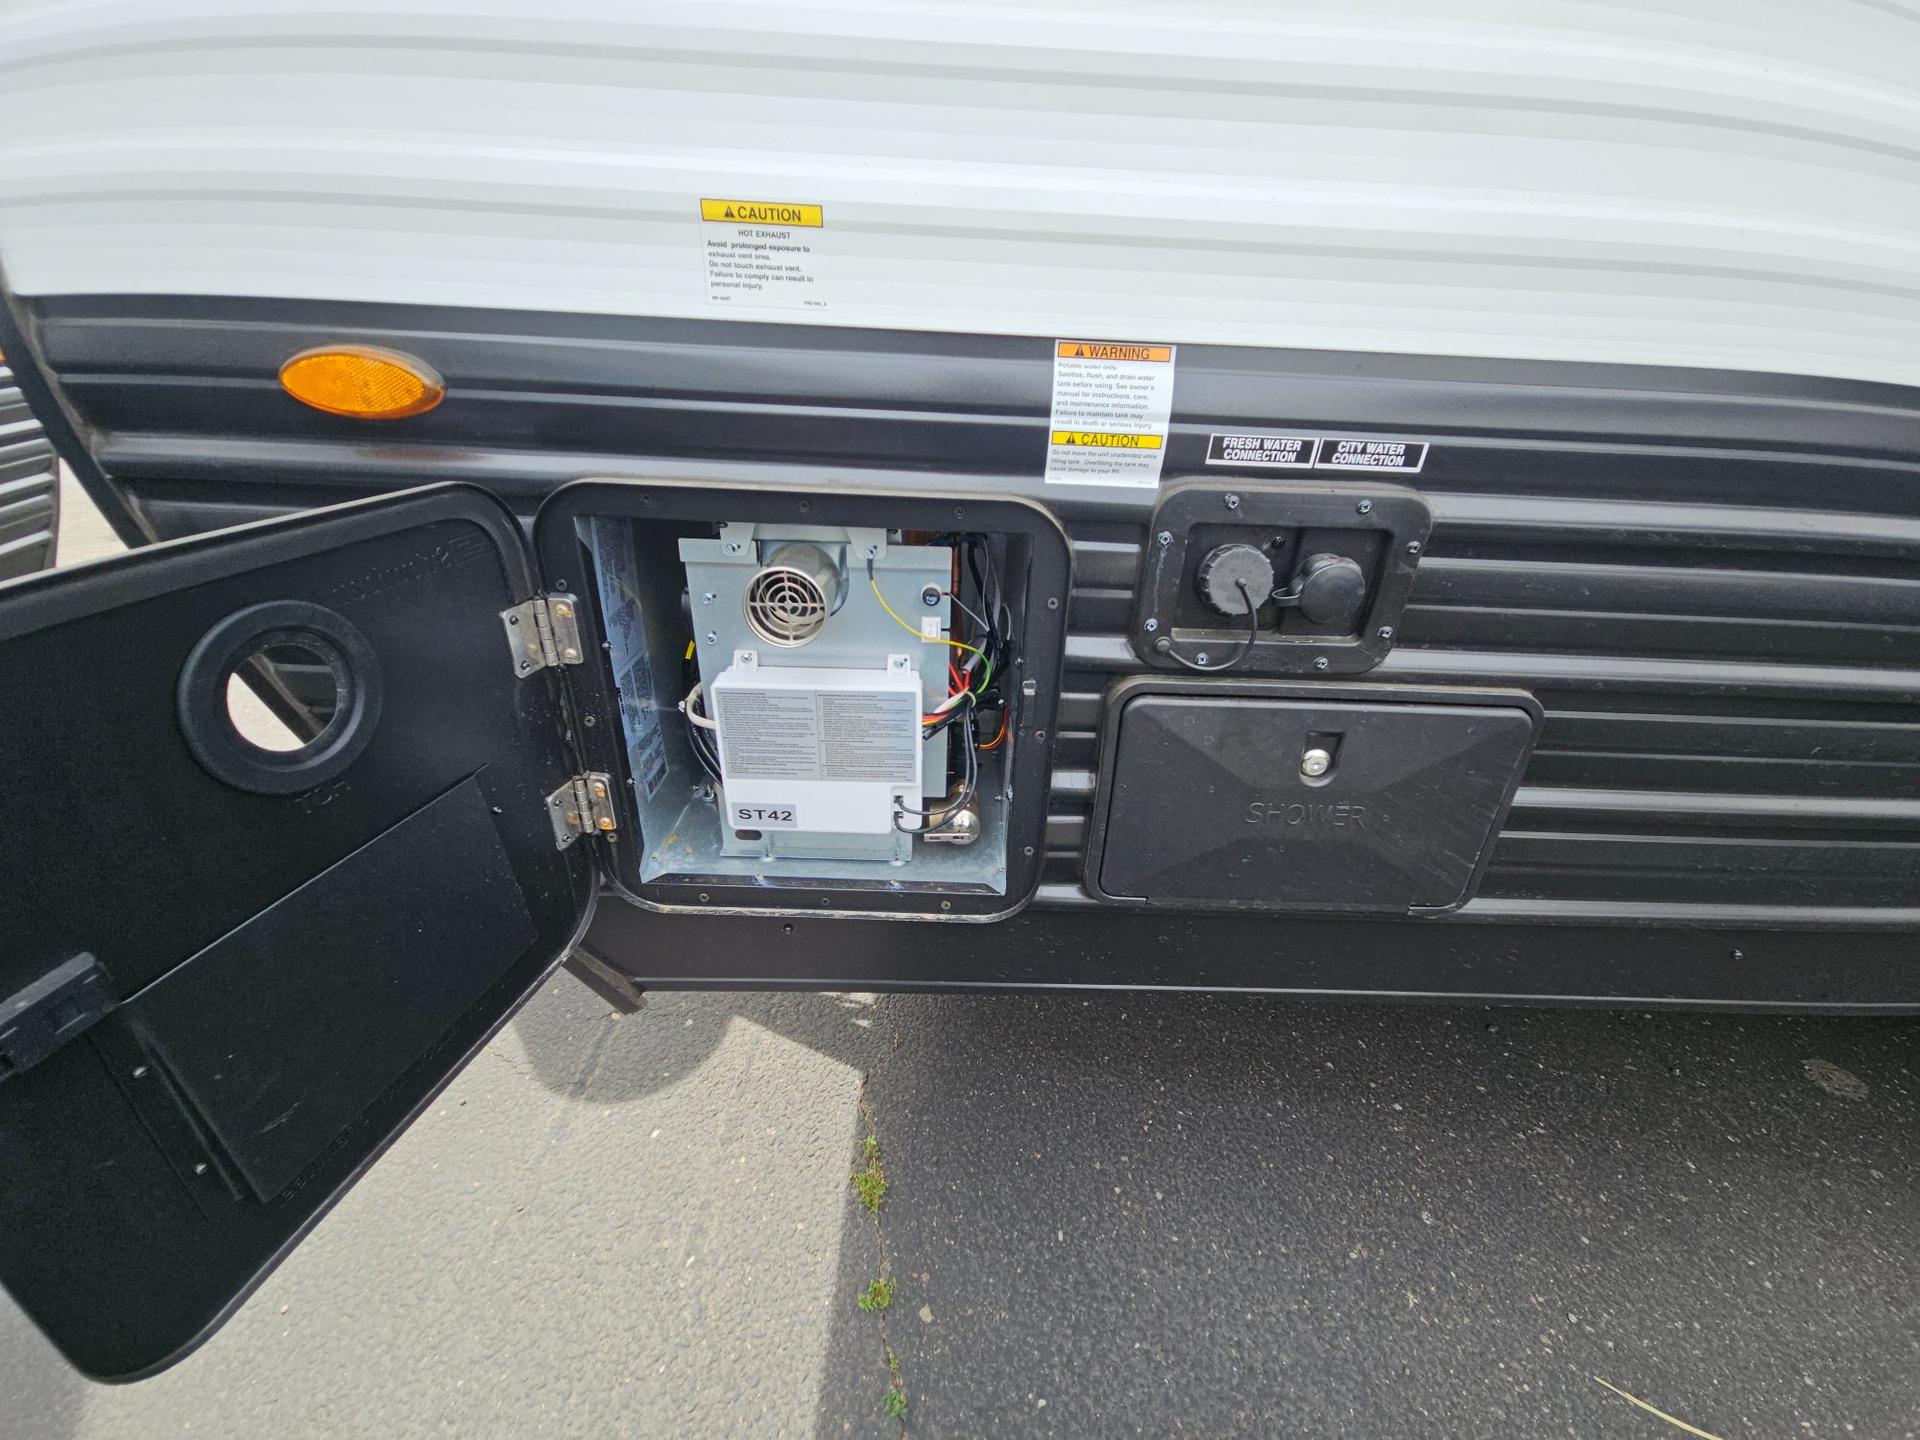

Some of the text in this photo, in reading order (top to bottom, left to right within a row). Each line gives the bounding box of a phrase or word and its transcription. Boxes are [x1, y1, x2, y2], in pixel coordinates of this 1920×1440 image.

[738, 206, 801, 222] CAUTION
[756, 230, 790, 238] EXHAUST
[731, 242, 766, 251] prolonged
[742, 282, 762, 290] injury.
[1089, 346, 1150, 360] WARNING
[1081, 434, 1139, 447] CAUTION
[1222, 438, 1302, 451] FRESH WATER
[1338, 442, 1405, 454] CITY WATER
[1224, 449, 1296, 462] CONNECTION
[1332, 453, 1405, 466] CONNECTION
[1085, 459, 1113, 467] Overfilling
[738, 809, 792, 822] ST42
[1246, 802, 1365, 829] SHOWER
